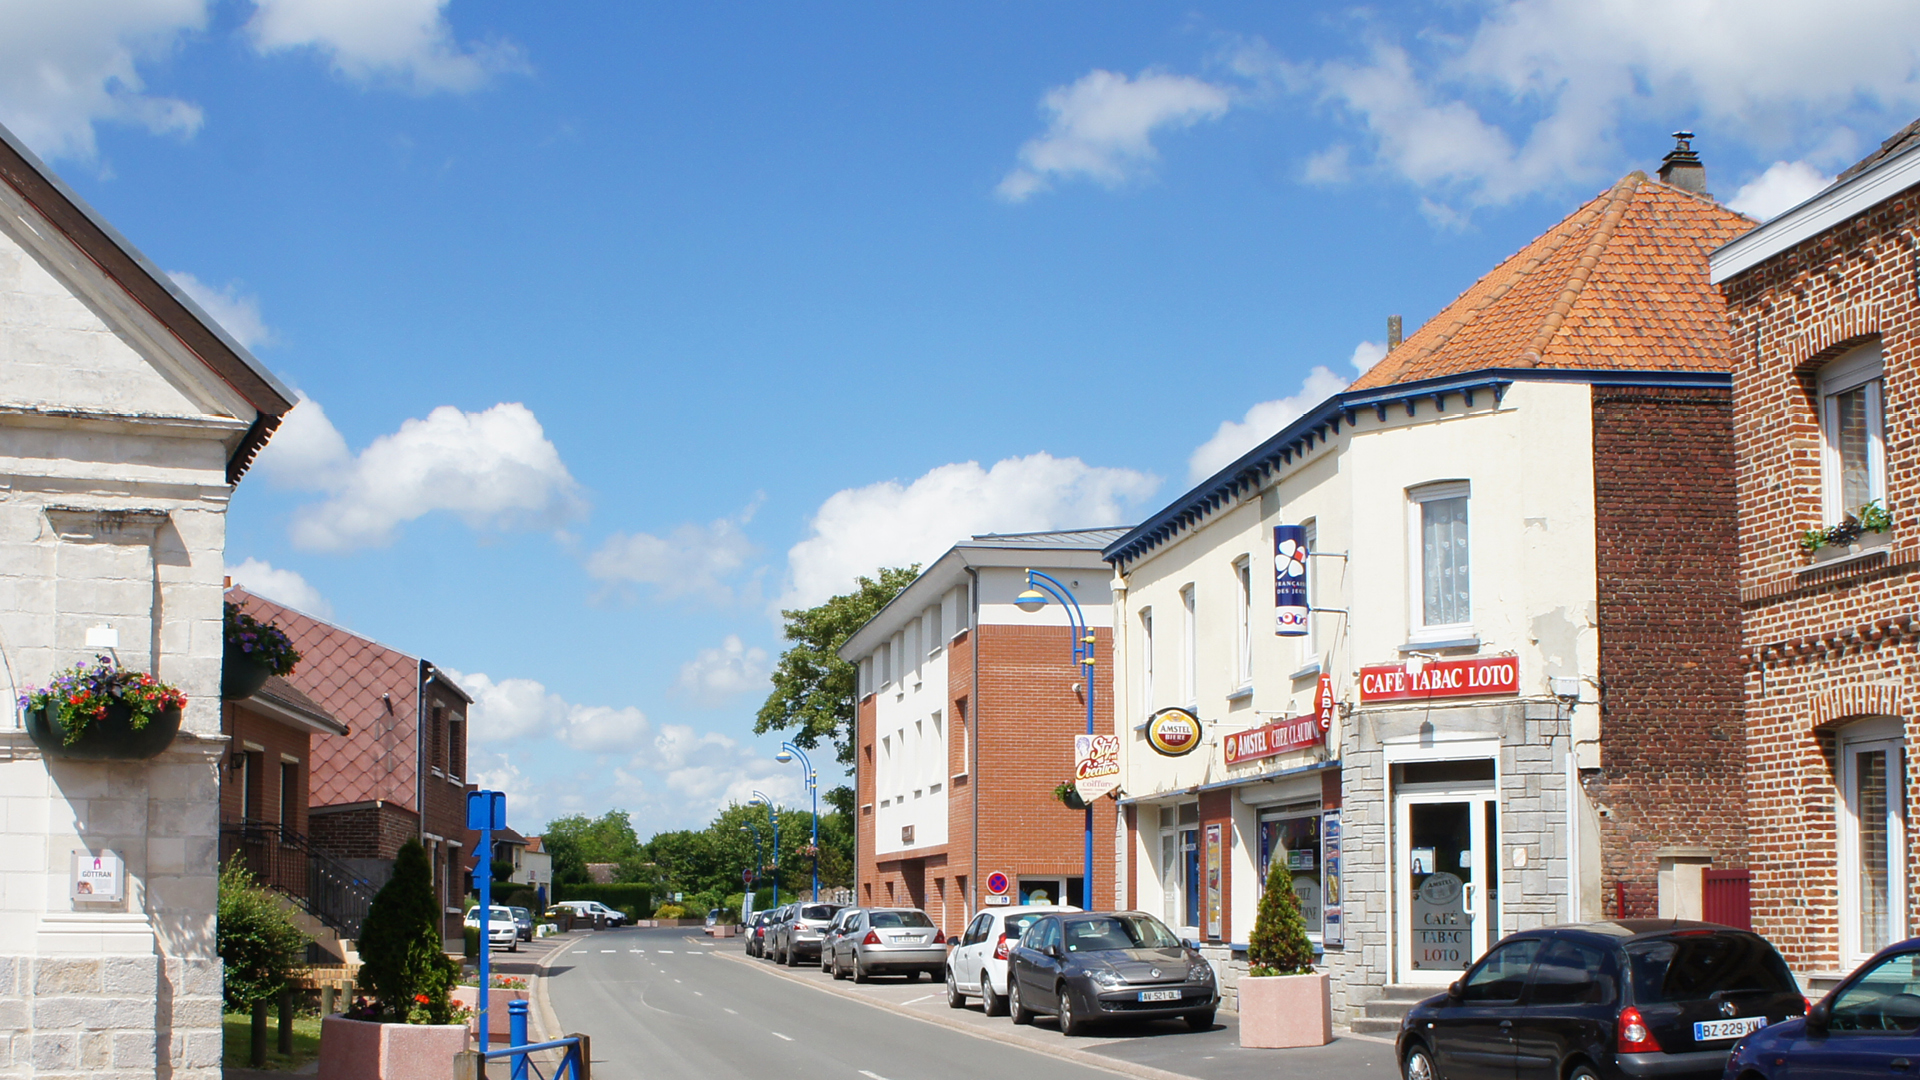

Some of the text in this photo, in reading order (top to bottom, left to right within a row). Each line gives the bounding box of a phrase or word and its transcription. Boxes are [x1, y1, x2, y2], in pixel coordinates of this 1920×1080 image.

[1363, 664, 1514, 694] CAFÉ TABAC LOTO
[1321, 678, 1332, 729] TABAC
[1160, 725, 1191, 733] AMSTEL
[1090, 735, 1119, 760] Style
[1238, 731, 1268, 757] AMSTEL
[1271, 727, 1289, 748] CHEZ
[1082, 780, 1113, 788] coiffure
[1428, 879, 1453, 888] AMSTEL
[1424, 909, 1458, 925] CAFÉ
[1420, 931, 1462, 943] TABAC
[1424, 949, 1459, 961] LOTO
